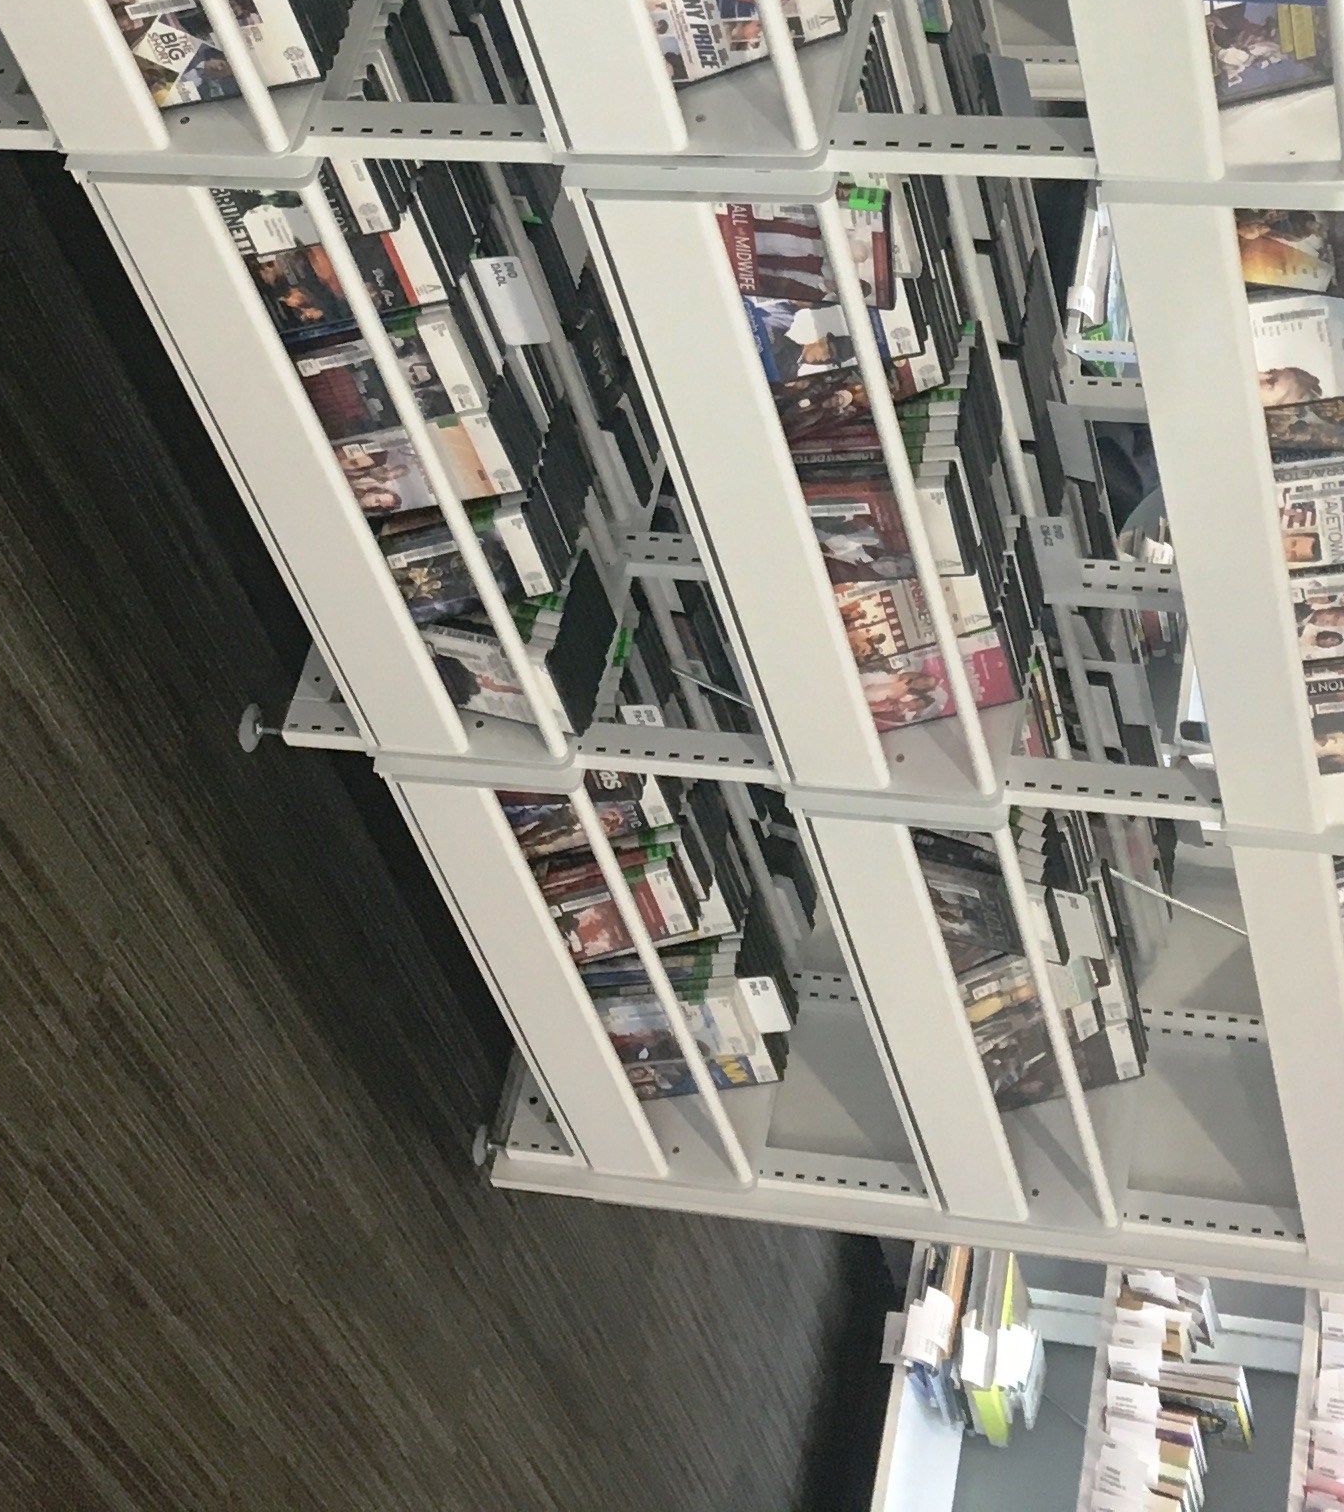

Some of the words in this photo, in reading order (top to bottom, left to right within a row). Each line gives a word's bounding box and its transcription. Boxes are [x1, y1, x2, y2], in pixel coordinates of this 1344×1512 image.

[148, 32, 172, 66] SHORT
[159, 31, 186, 62] BIG
[180, 34, 195, 55] THE
[689, 23, 721, 69] PRICE
[734, 235, 756, 292] MIDWIFE
